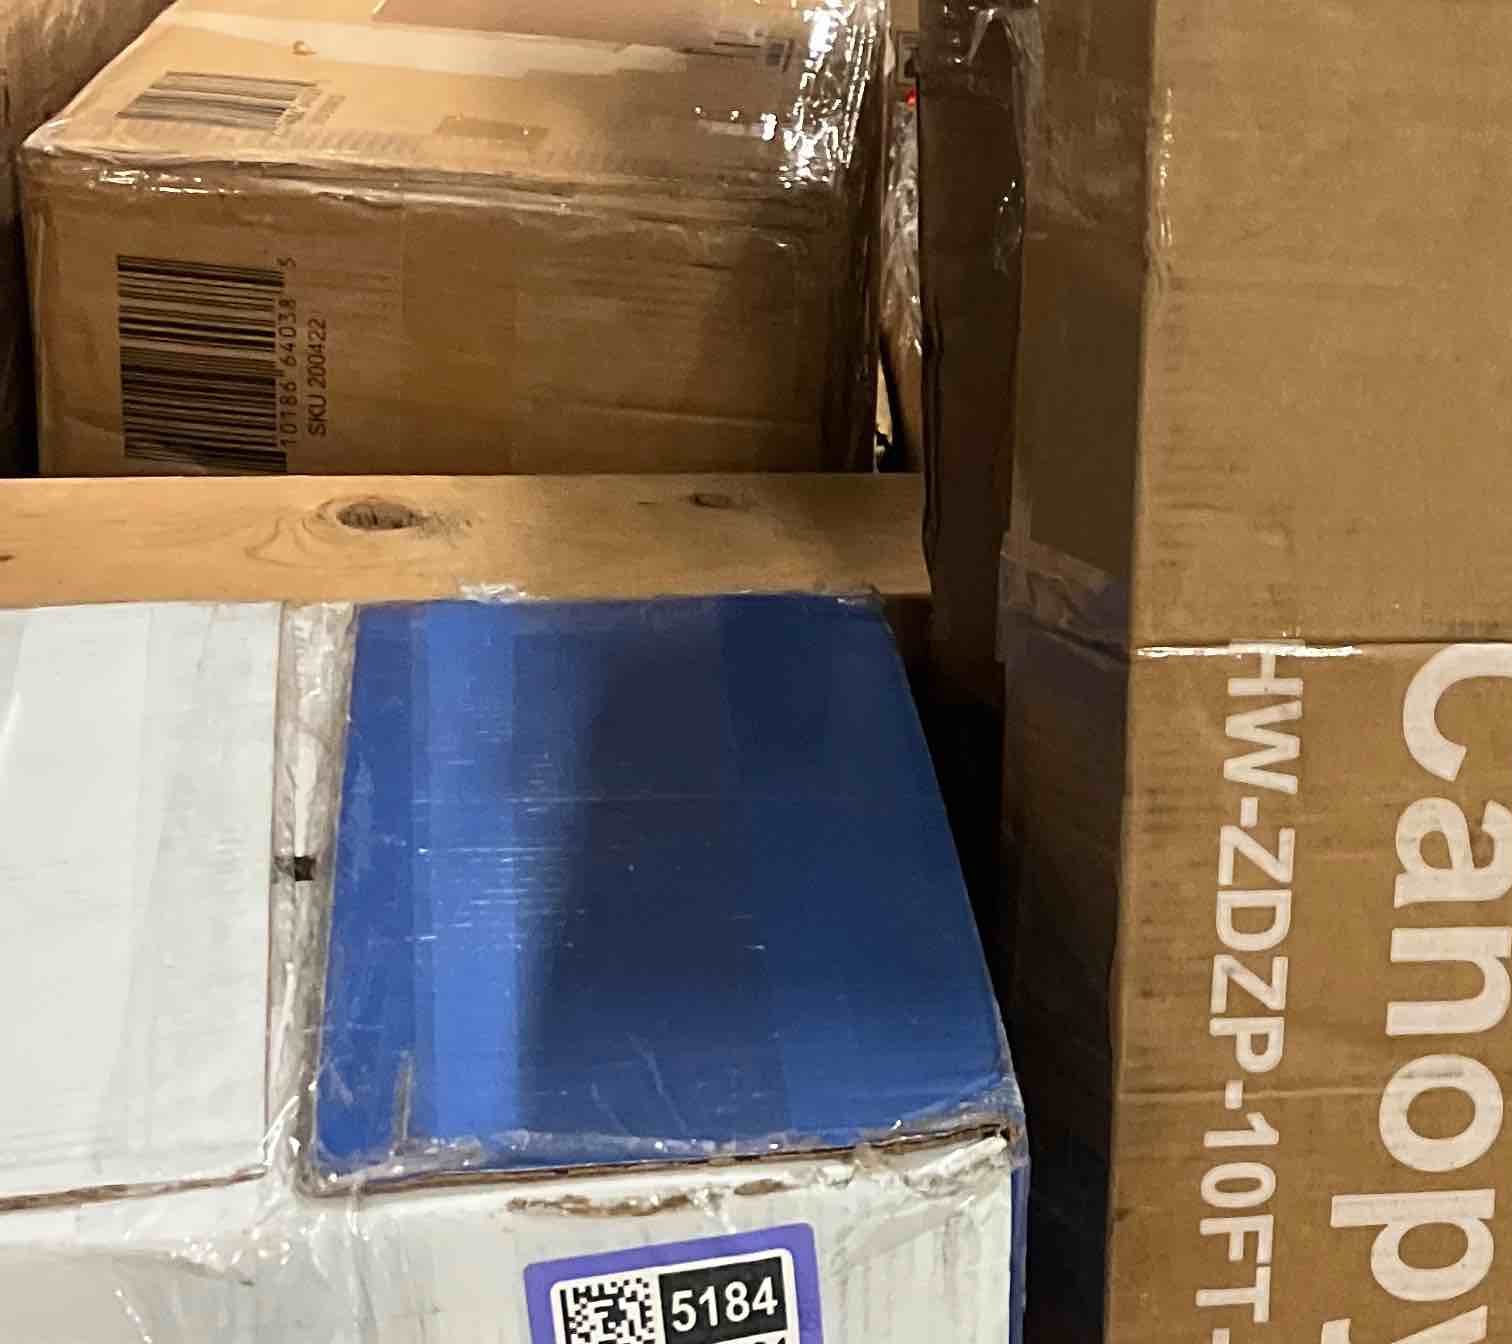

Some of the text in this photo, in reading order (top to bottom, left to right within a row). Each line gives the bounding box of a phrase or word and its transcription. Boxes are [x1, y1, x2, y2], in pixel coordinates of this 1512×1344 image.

[307, 318, 327, 438] SKU 200422
[671, 1276, 779, 1333] 5184
